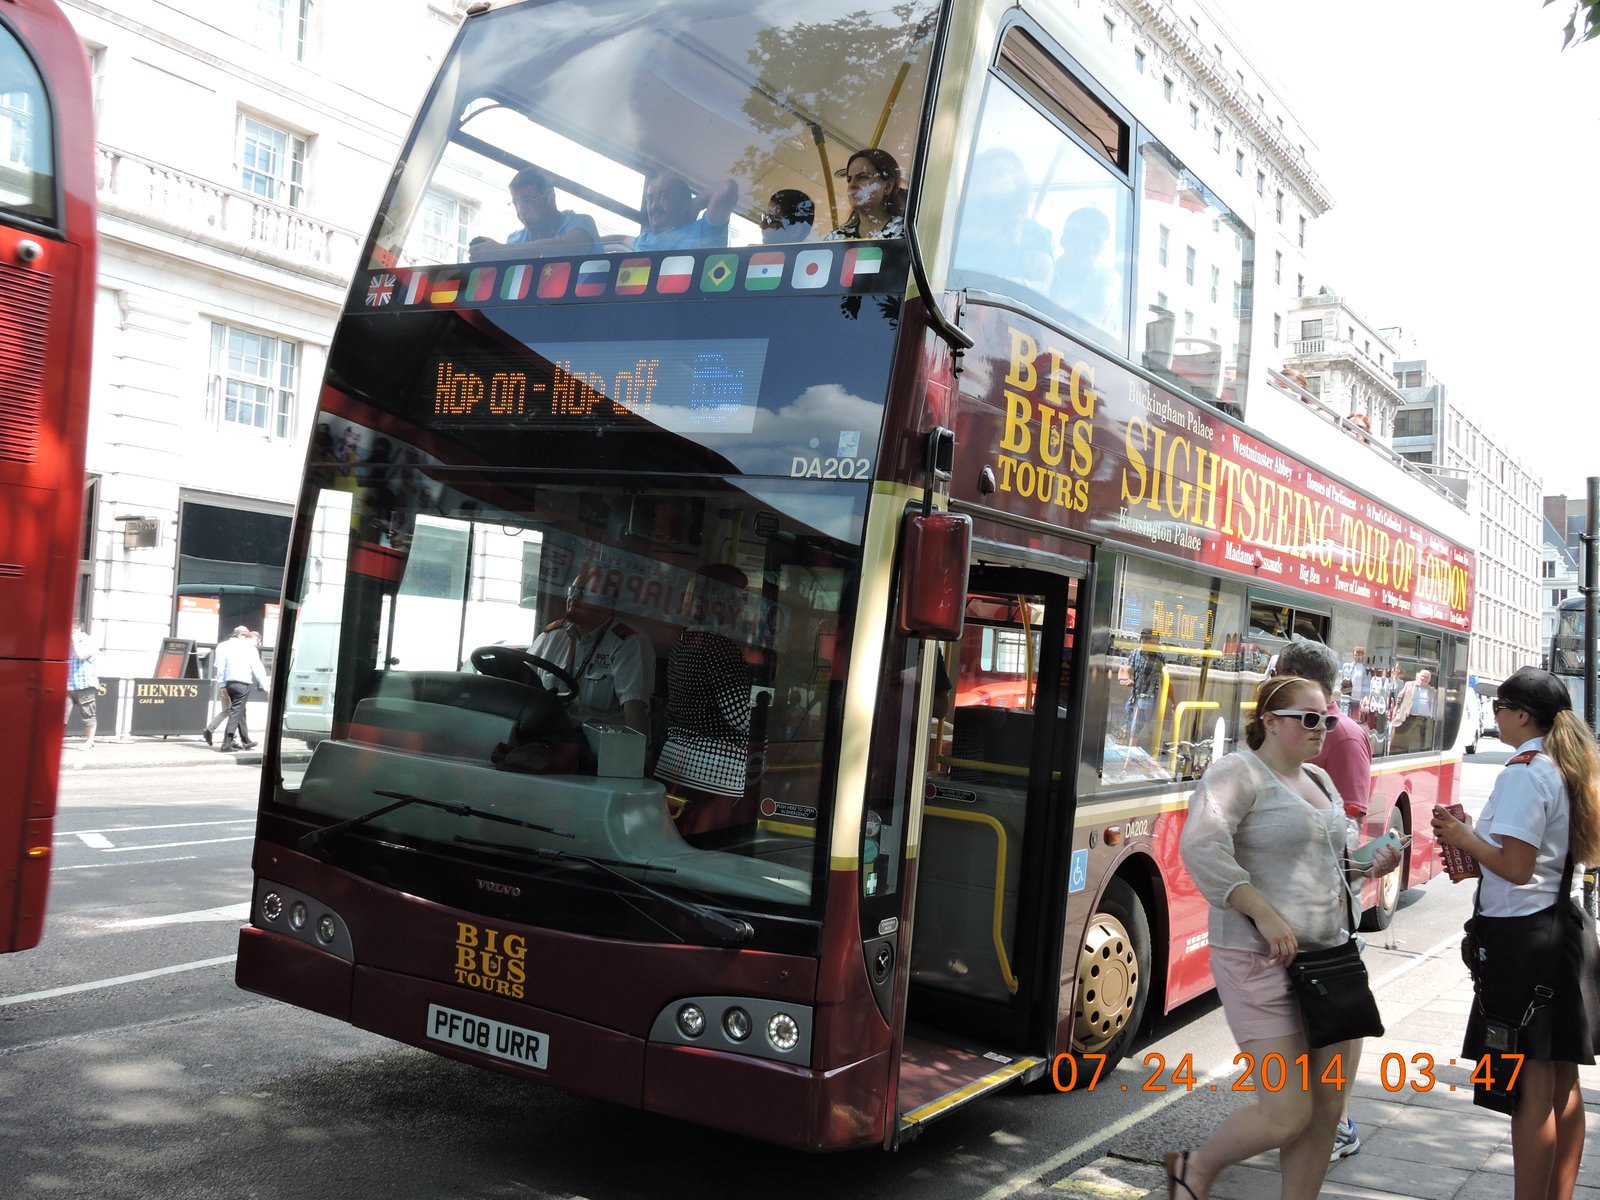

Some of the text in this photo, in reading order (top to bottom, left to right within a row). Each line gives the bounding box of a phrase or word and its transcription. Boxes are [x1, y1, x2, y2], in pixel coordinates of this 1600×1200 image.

[434, 361, 485, 415] Hop
[491, 371, 526, 415] on
[551, 360, 606, 415] Hop
[613, 359, 660, 416] off
[1004, 326, 1098, 420] BIG
[1000, 389, 1094, 476] BUS
[1128, 380, 1186, 427] Buckingham
[1187, 410, 1214, 442] Palace
[1232, 433, 1274, 471] Westminster
[1274, 456, 1293, 482] Abbey
[790, 456, 870, 480] DA202
[998, 454, 1090, 513] TOURS
[1121, 415, 1469, 612] SIGHTSEEING TOUR OF LONDON
[1118, 506, 1172, 543] Kensington
[1173, 524, 1202, 551] Palace
[1224, 540, 1254, 566] Madame
[1299, 563, 1310, 585] Big
[1309, 567, 1321, 585] Ben
[1335, 574, 1349, 592] Tower
[136, 684, 198, 697] HENRY'S
[1125, 819, 1148, 839] DA202
[476, 878, 521, 897] VOLVO
[455, 944, 527, 984] BUS
[456, 921, 528, 960] BIG
[454, 969, 525, 999] TOURS
[434, 1009, 540, 1063] PF08 URR
